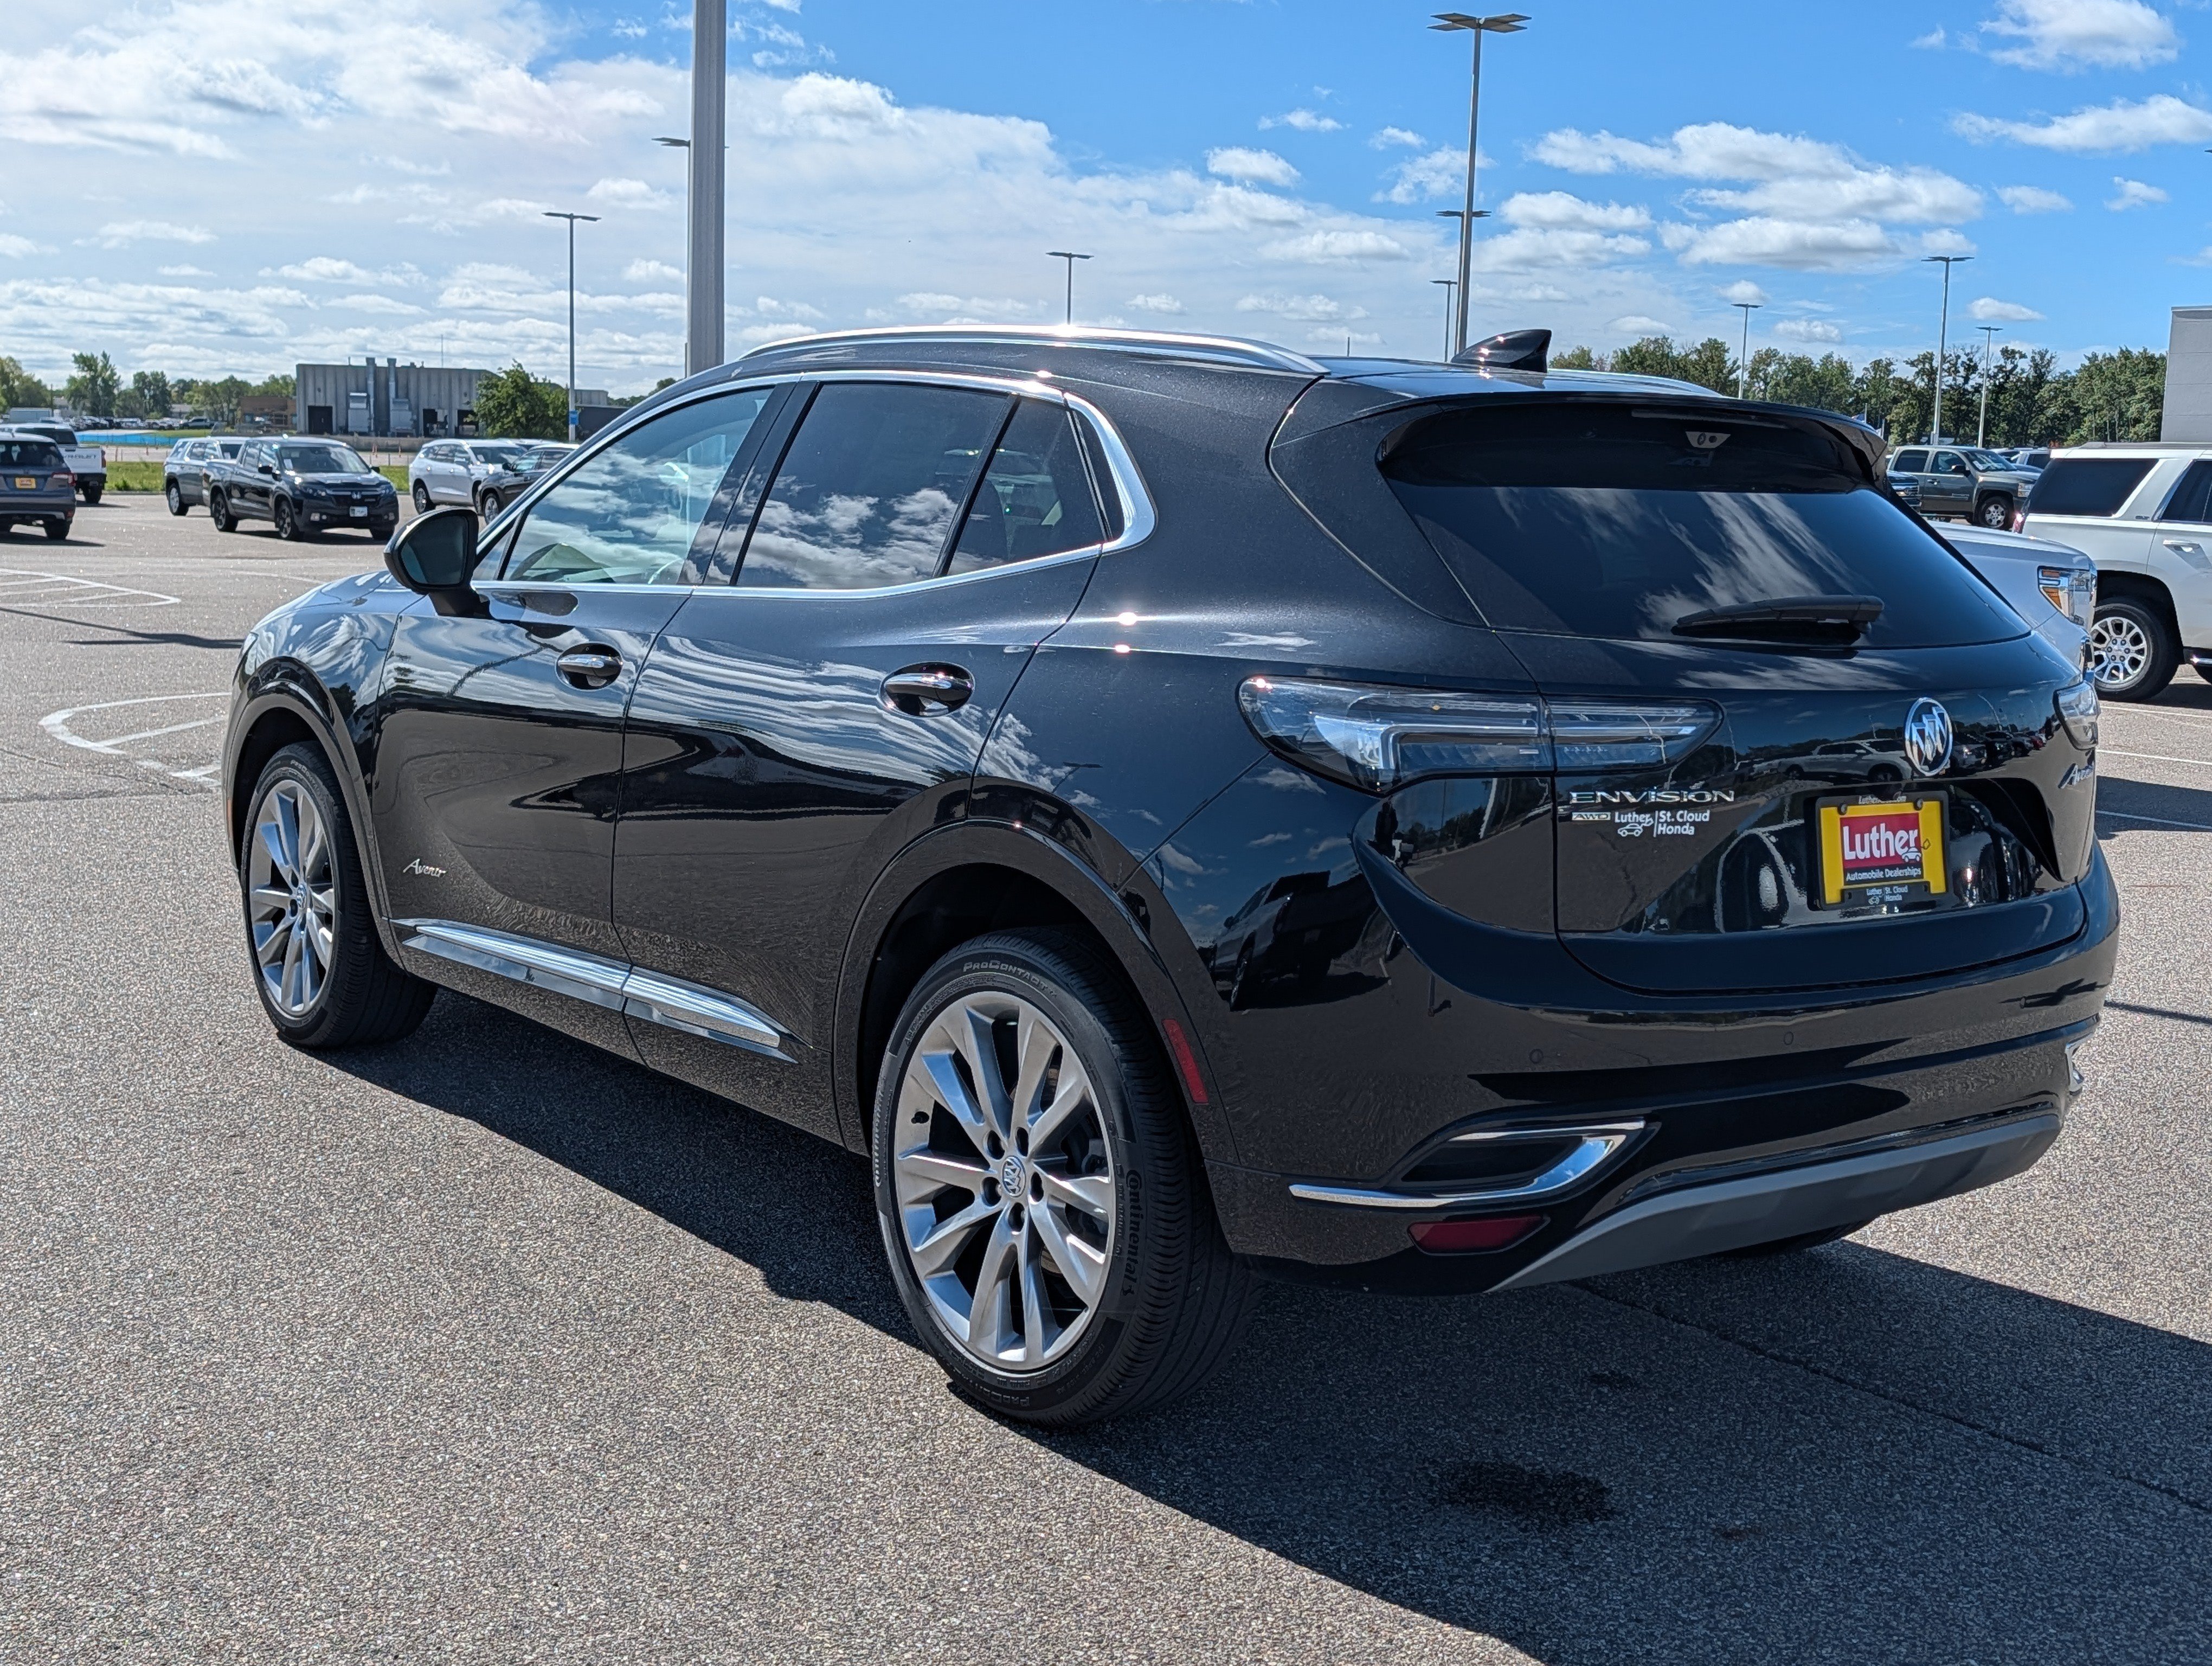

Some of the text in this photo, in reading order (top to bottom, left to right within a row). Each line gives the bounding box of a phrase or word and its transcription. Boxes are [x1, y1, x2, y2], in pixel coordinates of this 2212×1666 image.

[1569, 790, 1734, 804] ENVISION
[1572, 812, 1610, 821] AWD
[1615, 810, 1710, 823] Luther St. Cloud
[1657, 823, 1695, 835] Honda
[1843, 823, 1919, 860] Luther
[1846, 866, 1921, 881] Automobile Dealerships
[1124, 1169, 1143, 1283] Continental
